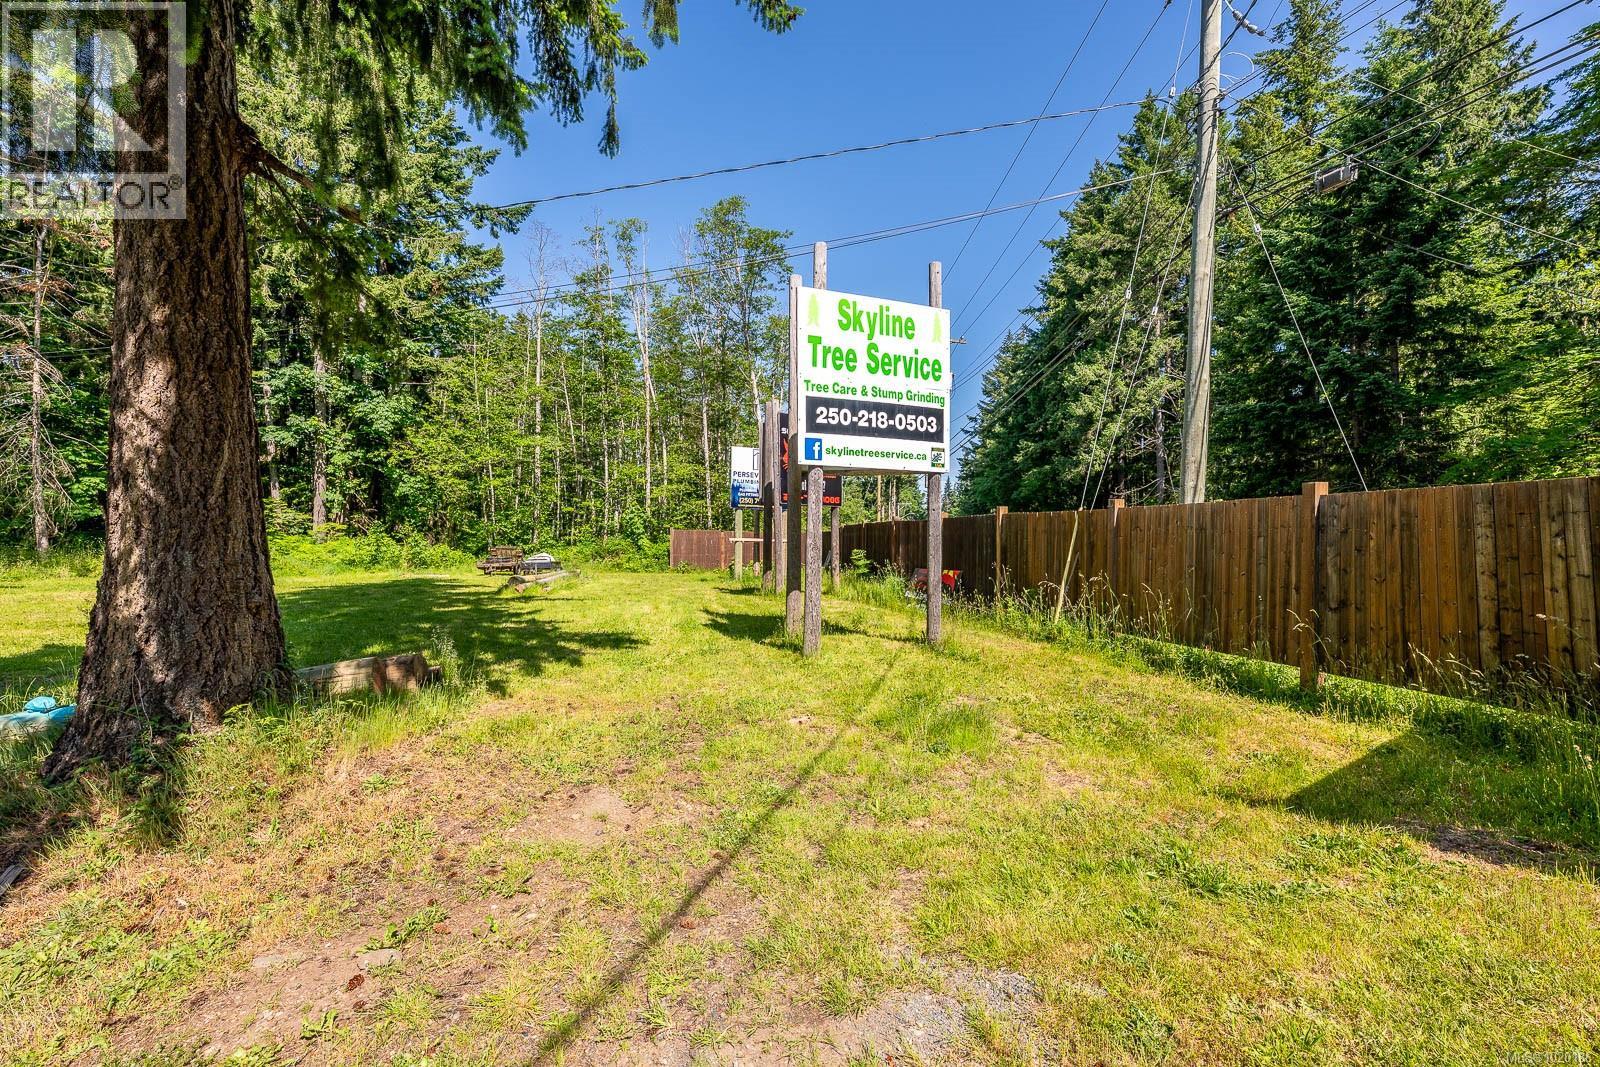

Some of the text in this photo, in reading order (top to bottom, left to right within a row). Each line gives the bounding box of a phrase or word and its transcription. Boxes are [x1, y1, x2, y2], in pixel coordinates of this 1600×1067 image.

[837, 298, 916, 341] Skyline
[807, 334, 942, 382] Tree Service
[803, 379, 945, 407] Tree Care & Stump Grinding
[816, 406, 937, 432] 250-218-0503
[825, 446, 927, 461] skylinetreeservice.ca
